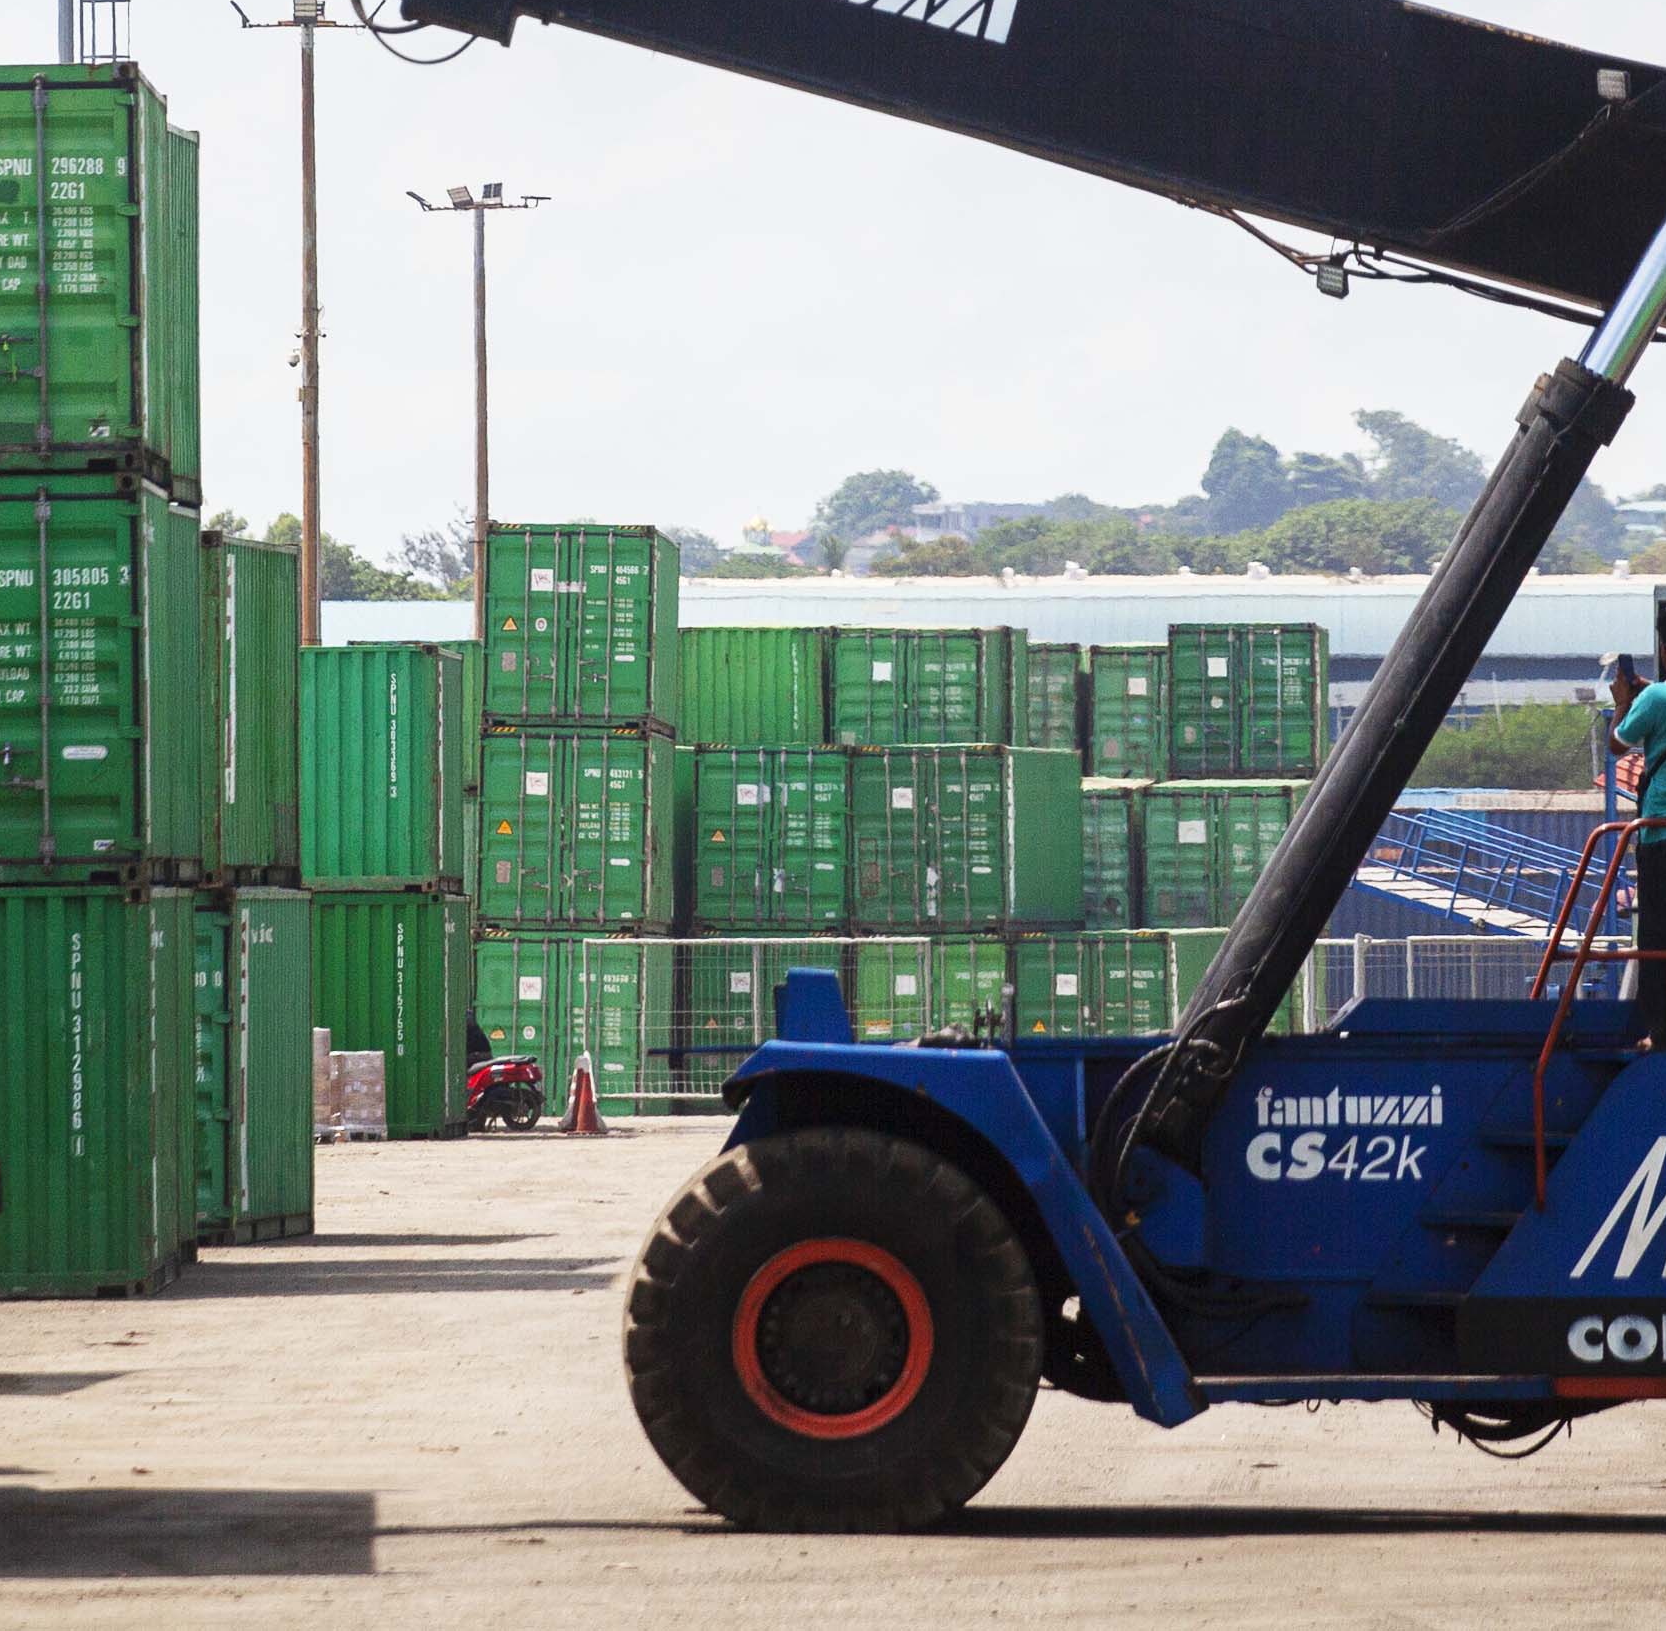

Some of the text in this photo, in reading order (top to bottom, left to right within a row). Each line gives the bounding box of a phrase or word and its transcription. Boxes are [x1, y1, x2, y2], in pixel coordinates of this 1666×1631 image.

[51, 156, 103, 175] 296288
[117, 156, 126, 176] 9
[51, 181, 84, 200] 22G1
[52, 568, 109, 586] 305805
[120, 565, 131, 586] 3
[53, 592, 90, 610] 22G1
[389, 673, 398, 716] SPNU
[70, 932, 82, 1010] SPNU
[71, 1015, 83, 1130] 312986
[1255, 1084, 1443, 1127] fantuzzi
[1245, 1131, 1427, 1181] CS42k
